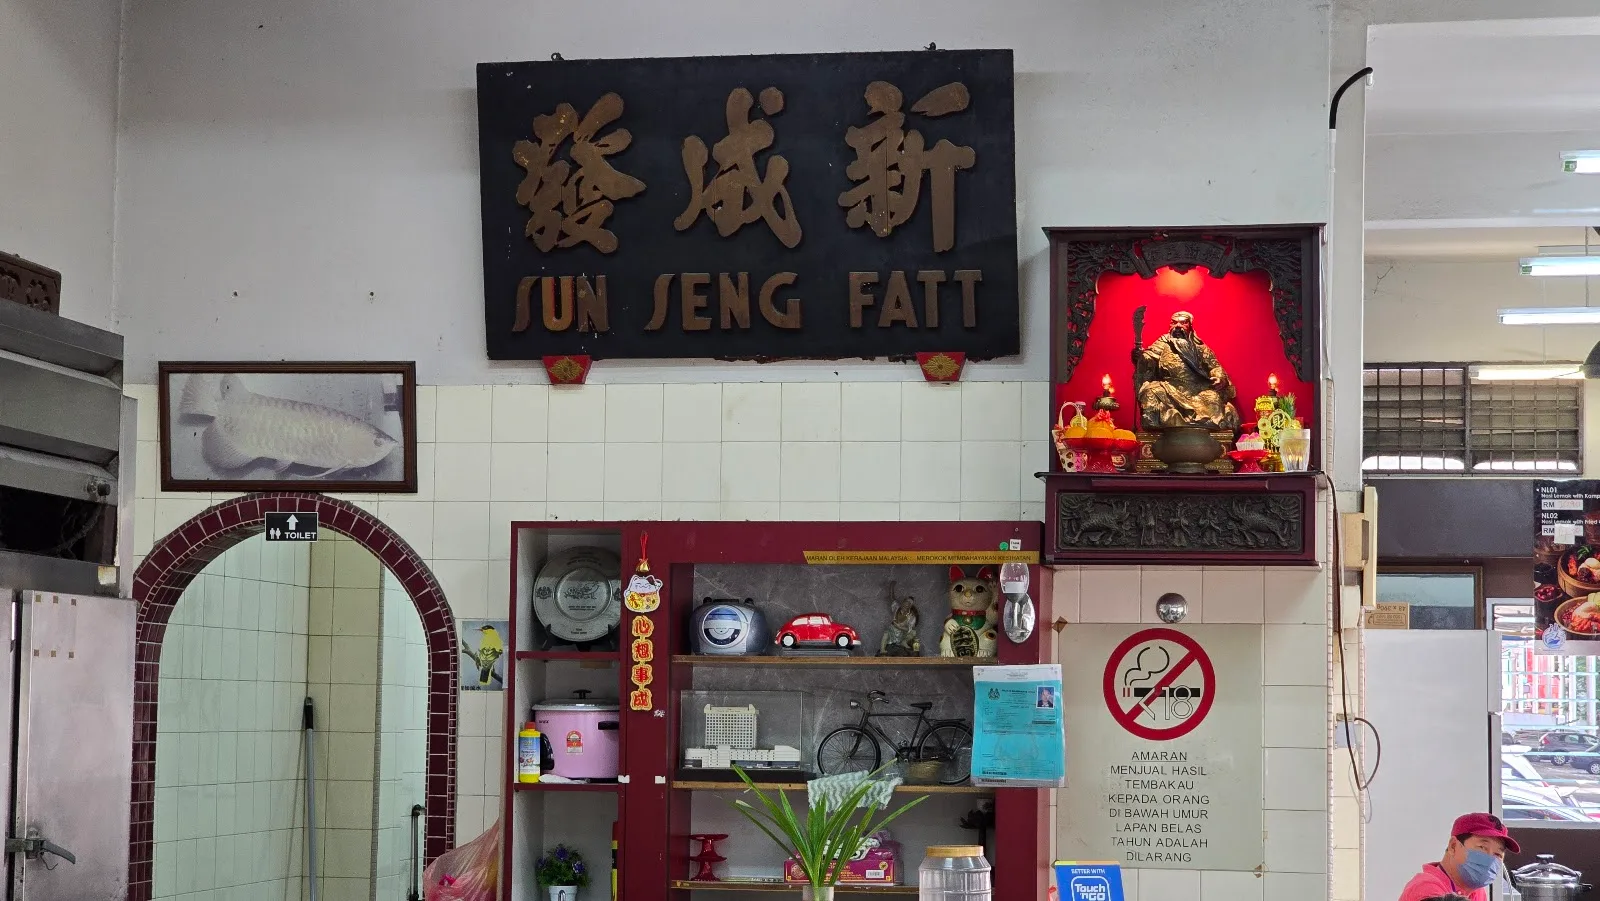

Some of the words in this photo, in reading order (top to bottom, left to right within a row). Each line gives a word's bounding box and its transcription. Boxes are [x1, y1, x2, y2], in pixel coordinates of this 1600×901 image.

[511, 273, 609, 333] SUN
[643, 271, 802, 332] SENG
[848, 269, 983, 329] FATT
[284, 531, 317, 540] TOILET
[634, 620, 650, 707] 心想事成
[1131, 751, 1188, 761] AMARAN
[1110, 765, 1168, 775] MENJUAL
[1171, 766, 1207, 776] HASIL
[1125, 779, 1194, 790] TEMBAKAU
[1108, 794, 1158, 804] KEPADA
[1162, 794, 1210, 805] ORANG
[1109, 808, 1121, 818] DI
[1124, 808, 1169, 818] BAWAH
[1172, 809, 1209, 819] UMUR
[1115, 822, 1157, 832] LAPAN
[1161, 823, 1202, 833] BELAS
[1111, 836, 1151, 847] TAHUN
[1155, 837, 1208, 848] ADALAH
[1126, 851, 1192, 862] DILARANG
[1074, 883, 1106, 892] Touch
